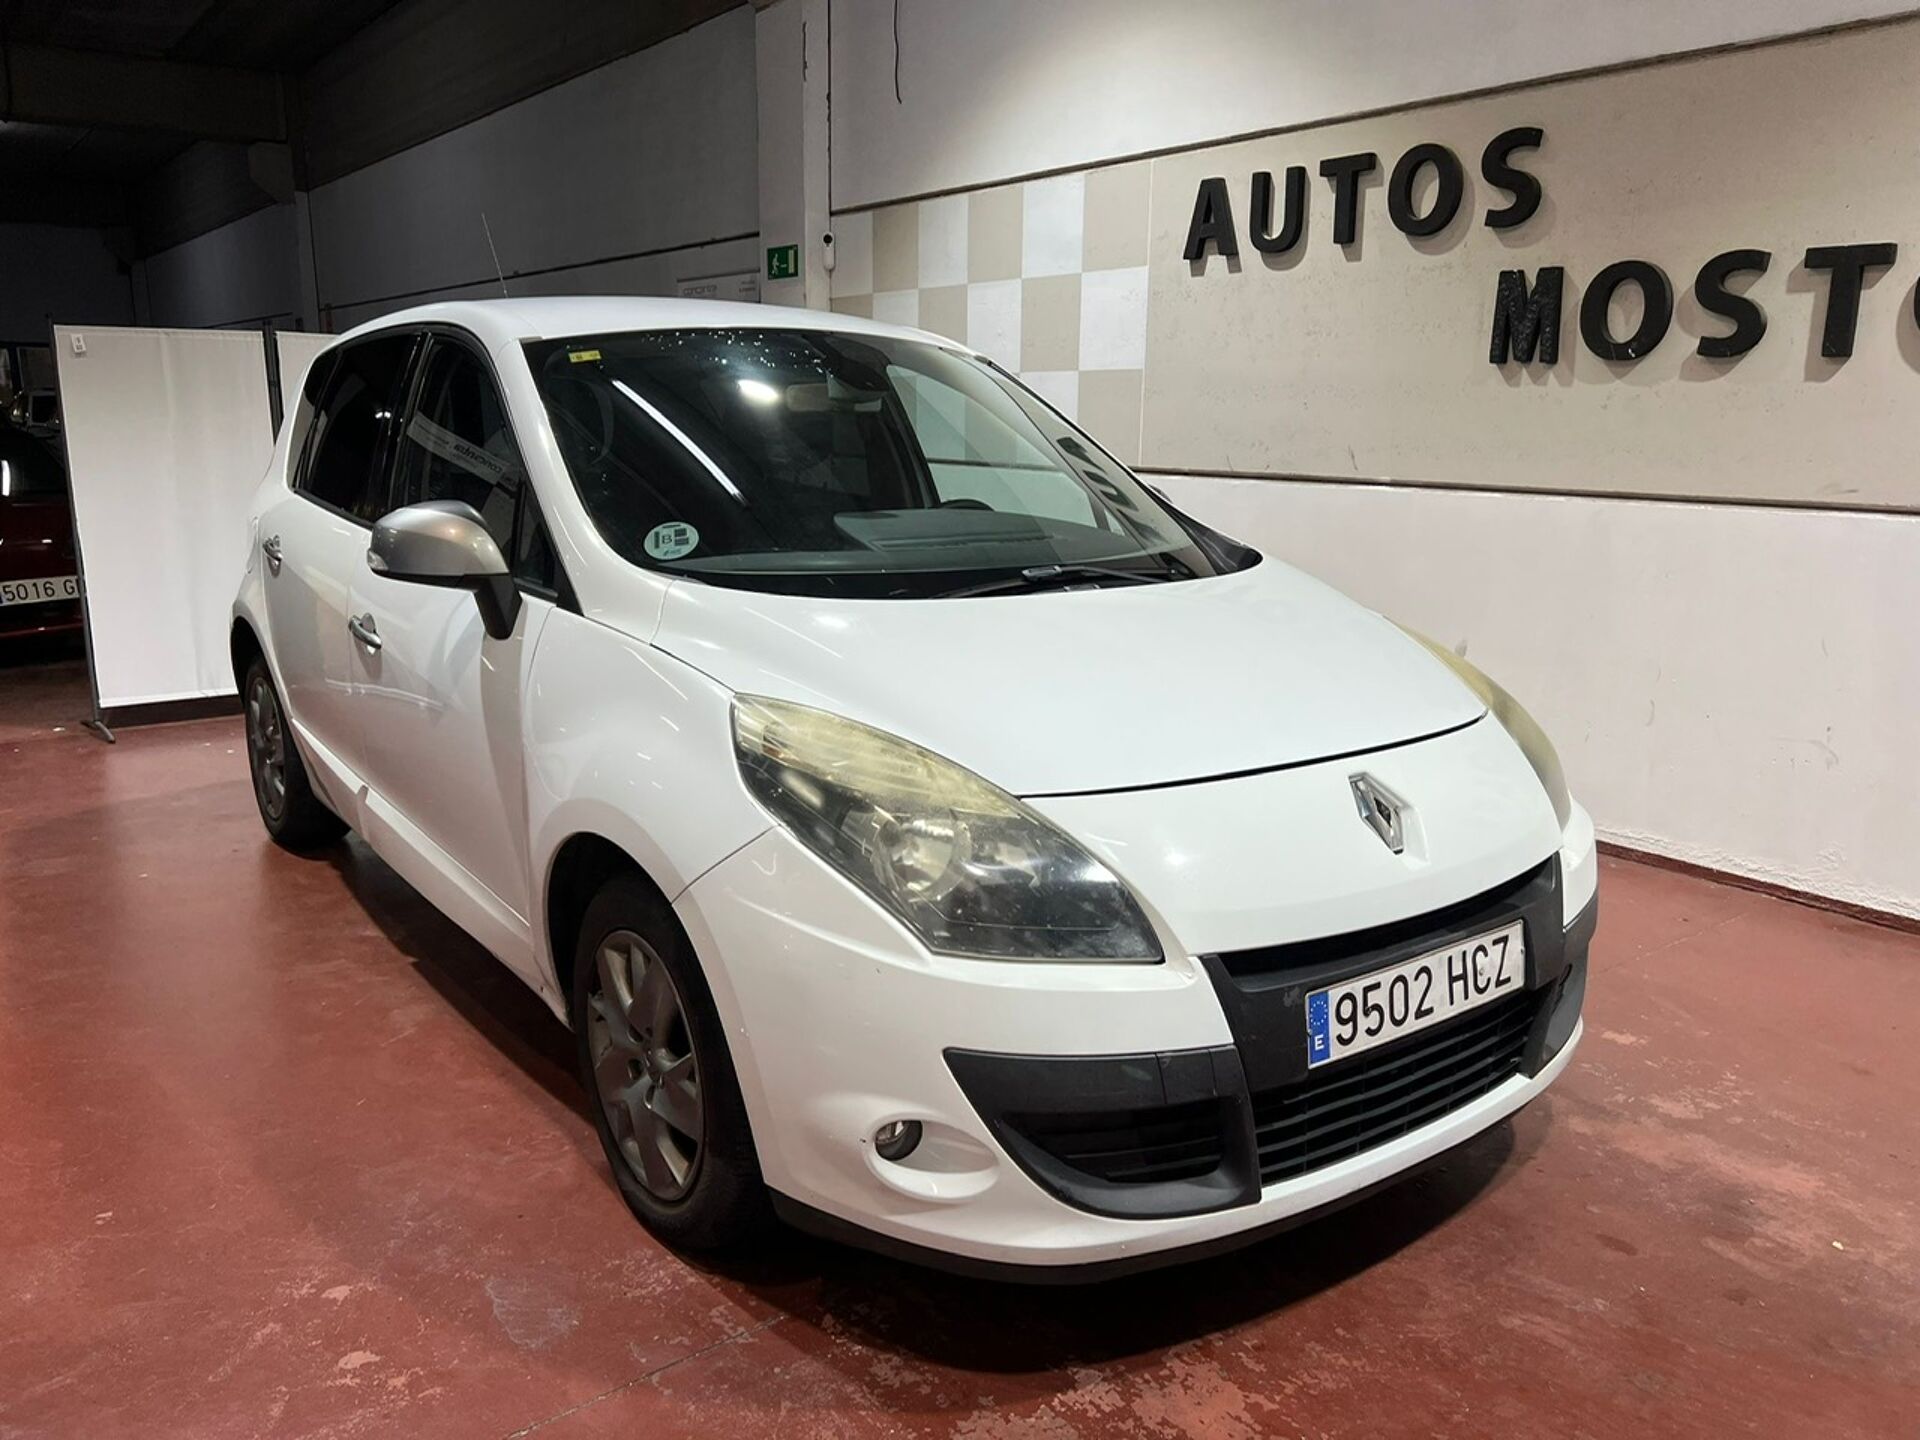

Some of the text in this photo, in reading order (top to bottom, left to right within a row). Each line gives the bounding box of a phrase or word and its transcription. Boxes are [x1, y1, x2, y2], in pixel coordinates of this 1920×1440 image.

[1183, 127, 1544, 266] AUTOS
[1490, 243, 1920, 368] MOST
[662, 534, 673, 544] B
[2, 579, 80, 602] 5016 G
[1335, 935, 1511, 1047] 9502 HCZ
[1314, 1034, 1324, 1051] E
